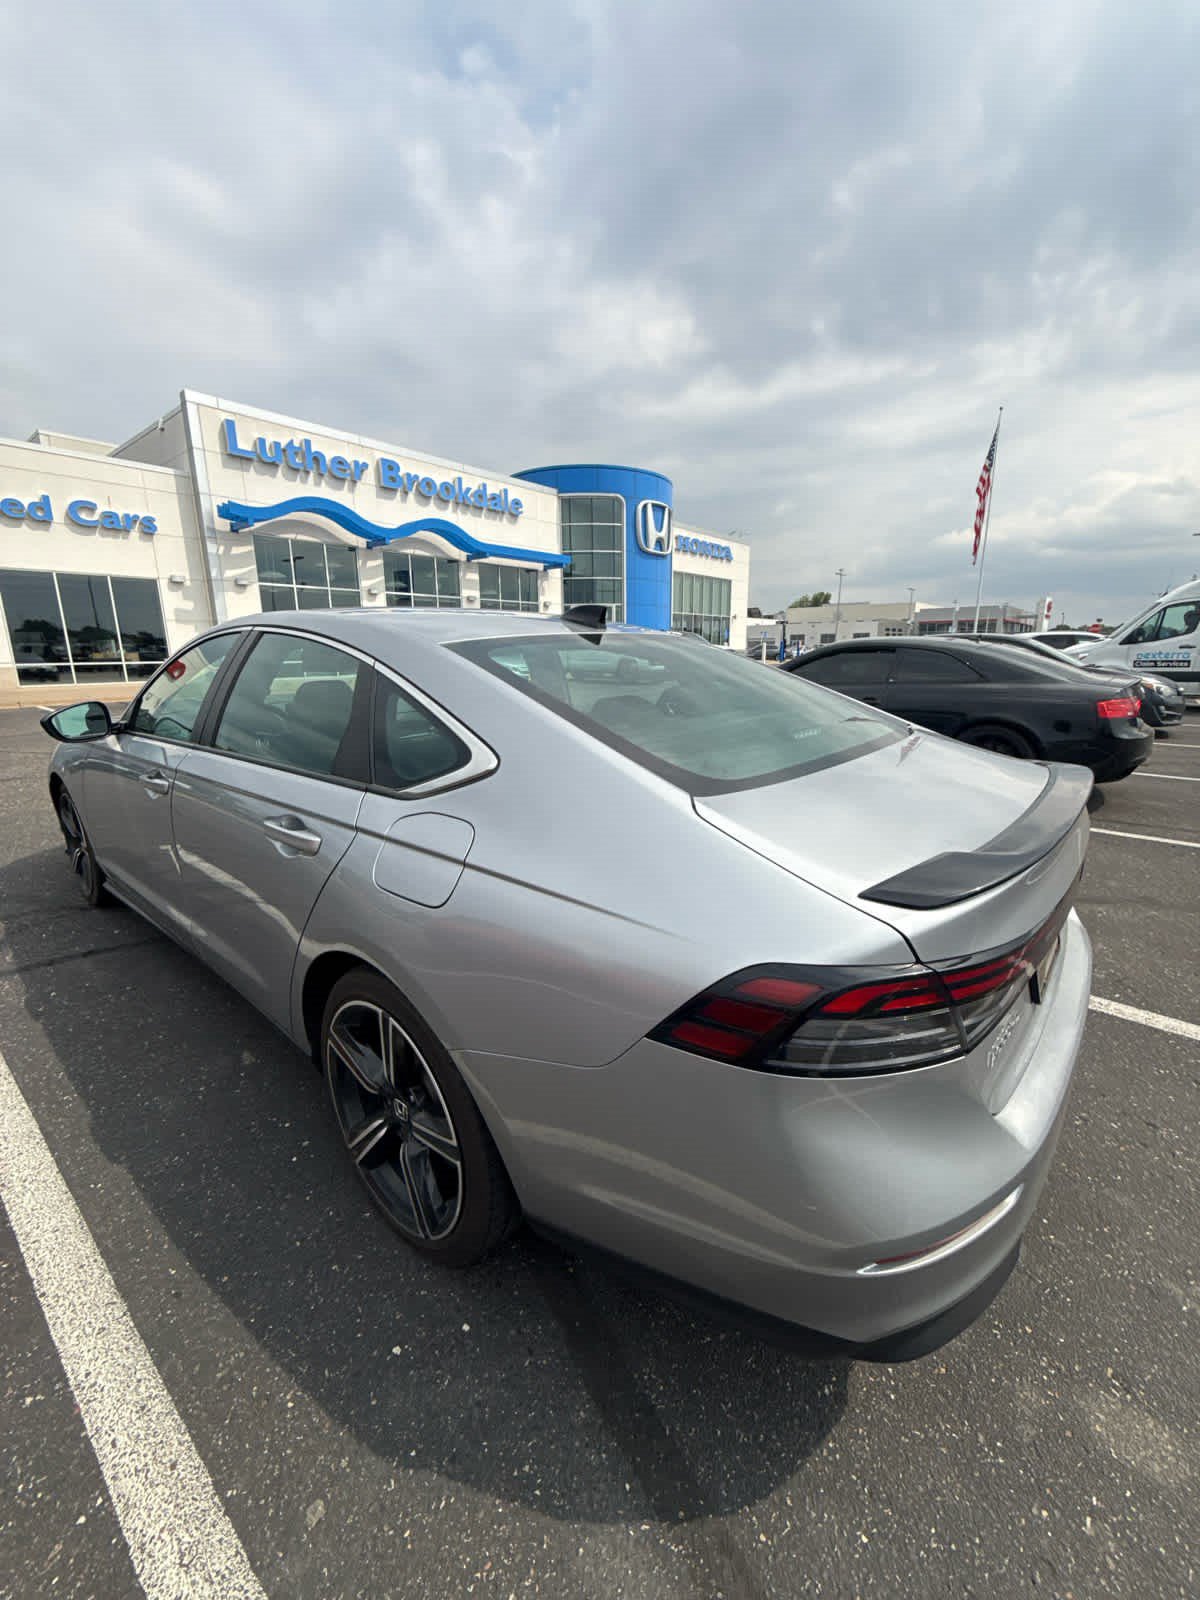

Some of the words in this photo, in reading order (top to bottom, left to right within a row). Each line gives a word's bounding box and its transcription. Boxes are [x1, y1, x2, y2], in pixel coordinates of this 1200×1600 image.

[222, 418, 369, 482] Luther
[378, 457, 524, 517] Brookdale
[67, 499, 158, 534] Cars
[675, 534, 734, 561] HONDA
